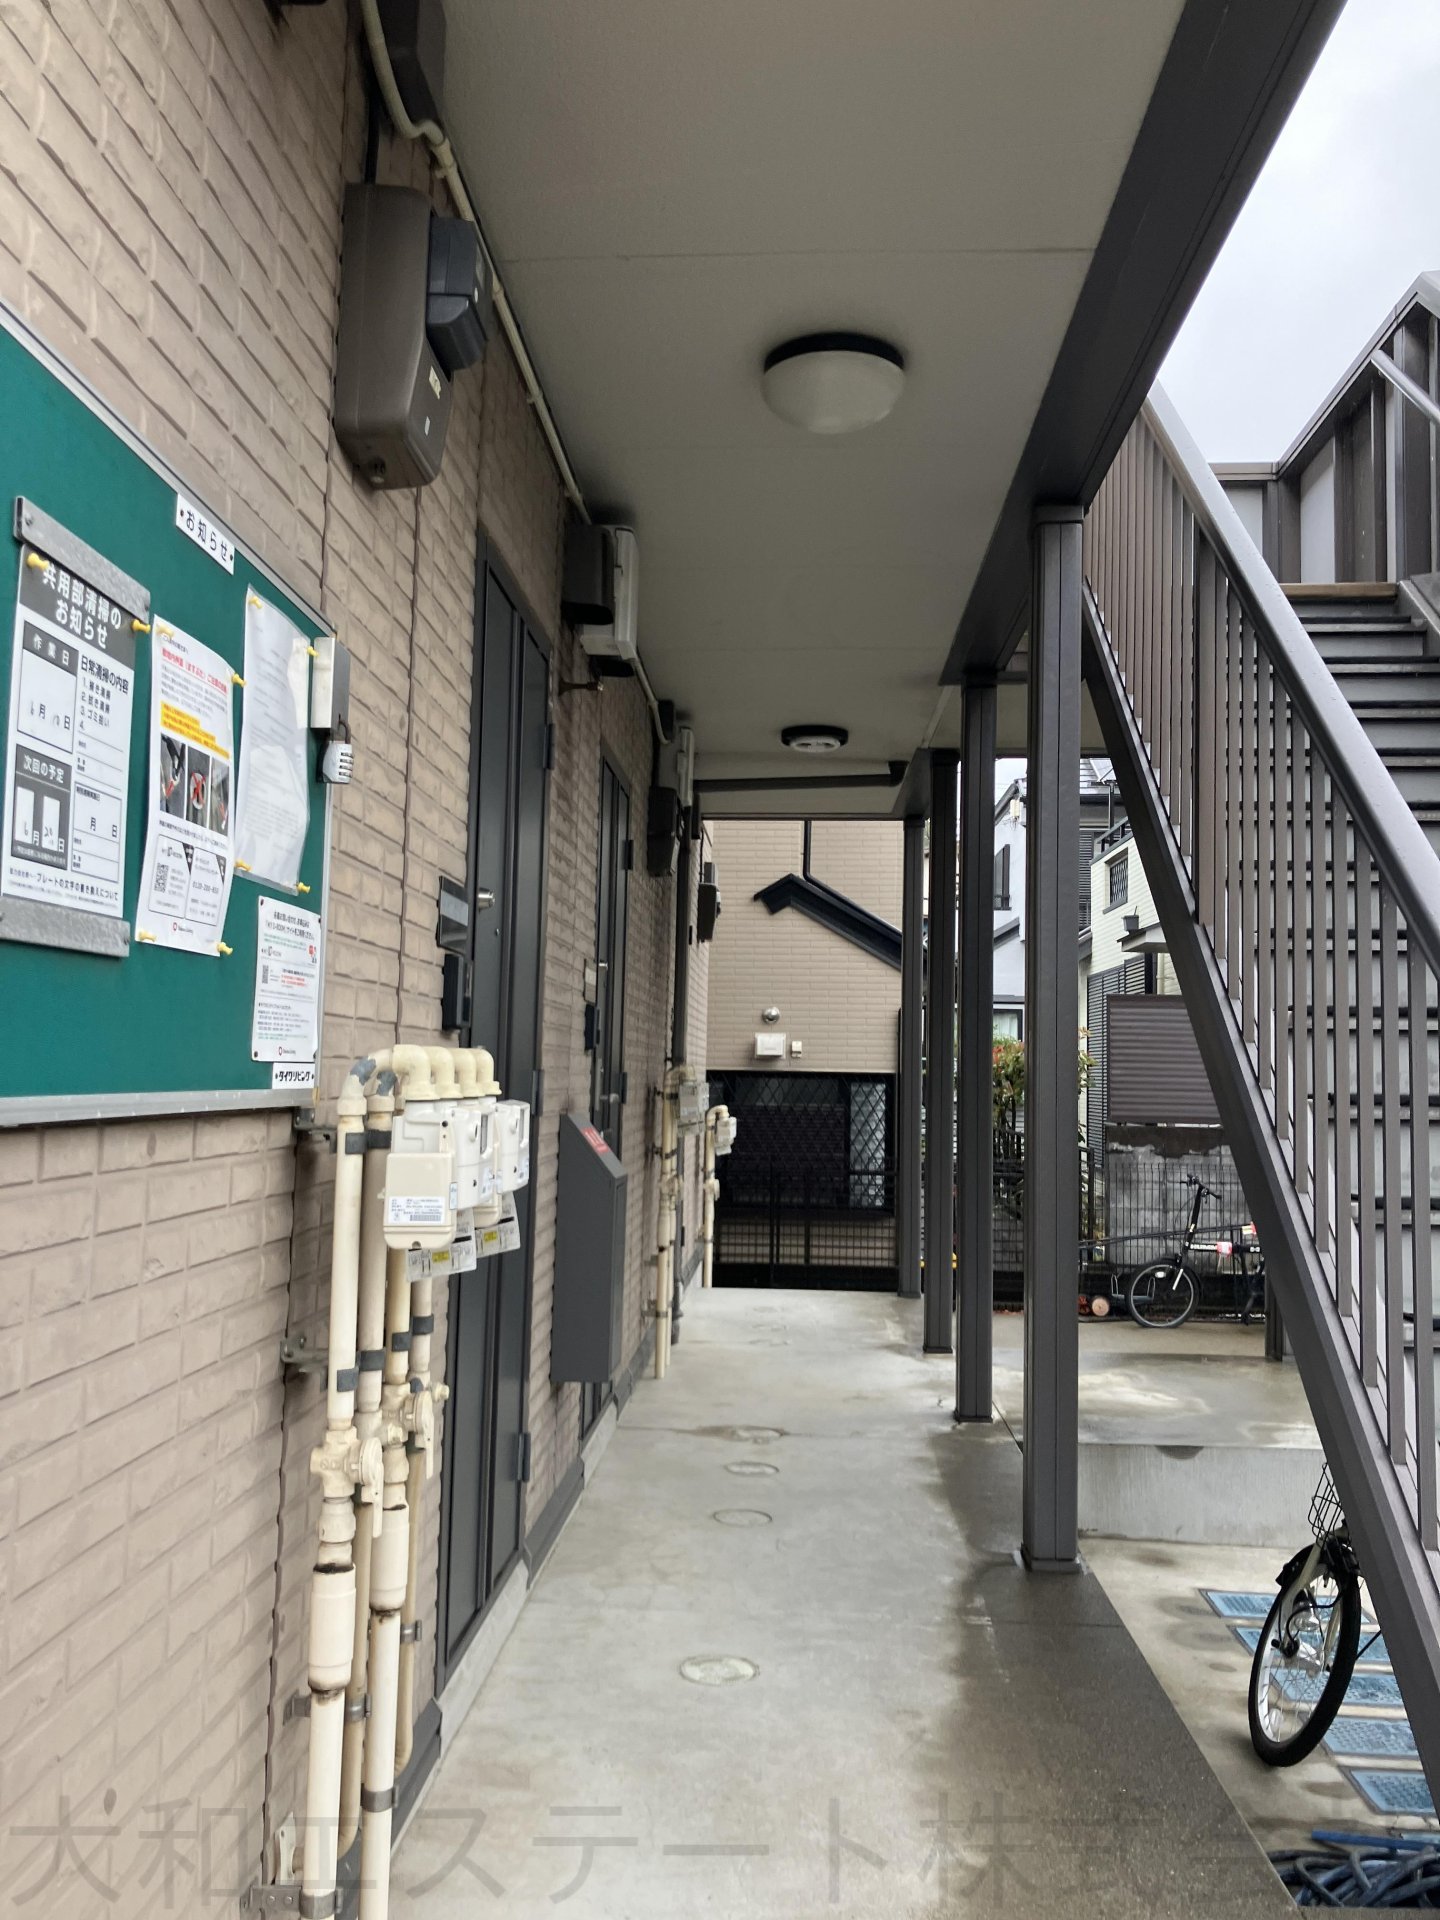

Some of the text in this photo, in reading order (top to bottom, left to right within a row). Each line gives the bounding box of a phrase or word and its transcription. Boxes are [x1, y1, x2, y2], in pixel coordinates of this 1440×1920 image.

[186, 510, 227, 562] お知らせ
[55, 599, 108, 649] お知らせ
[23, 754, 64, 784] 次回の予定
